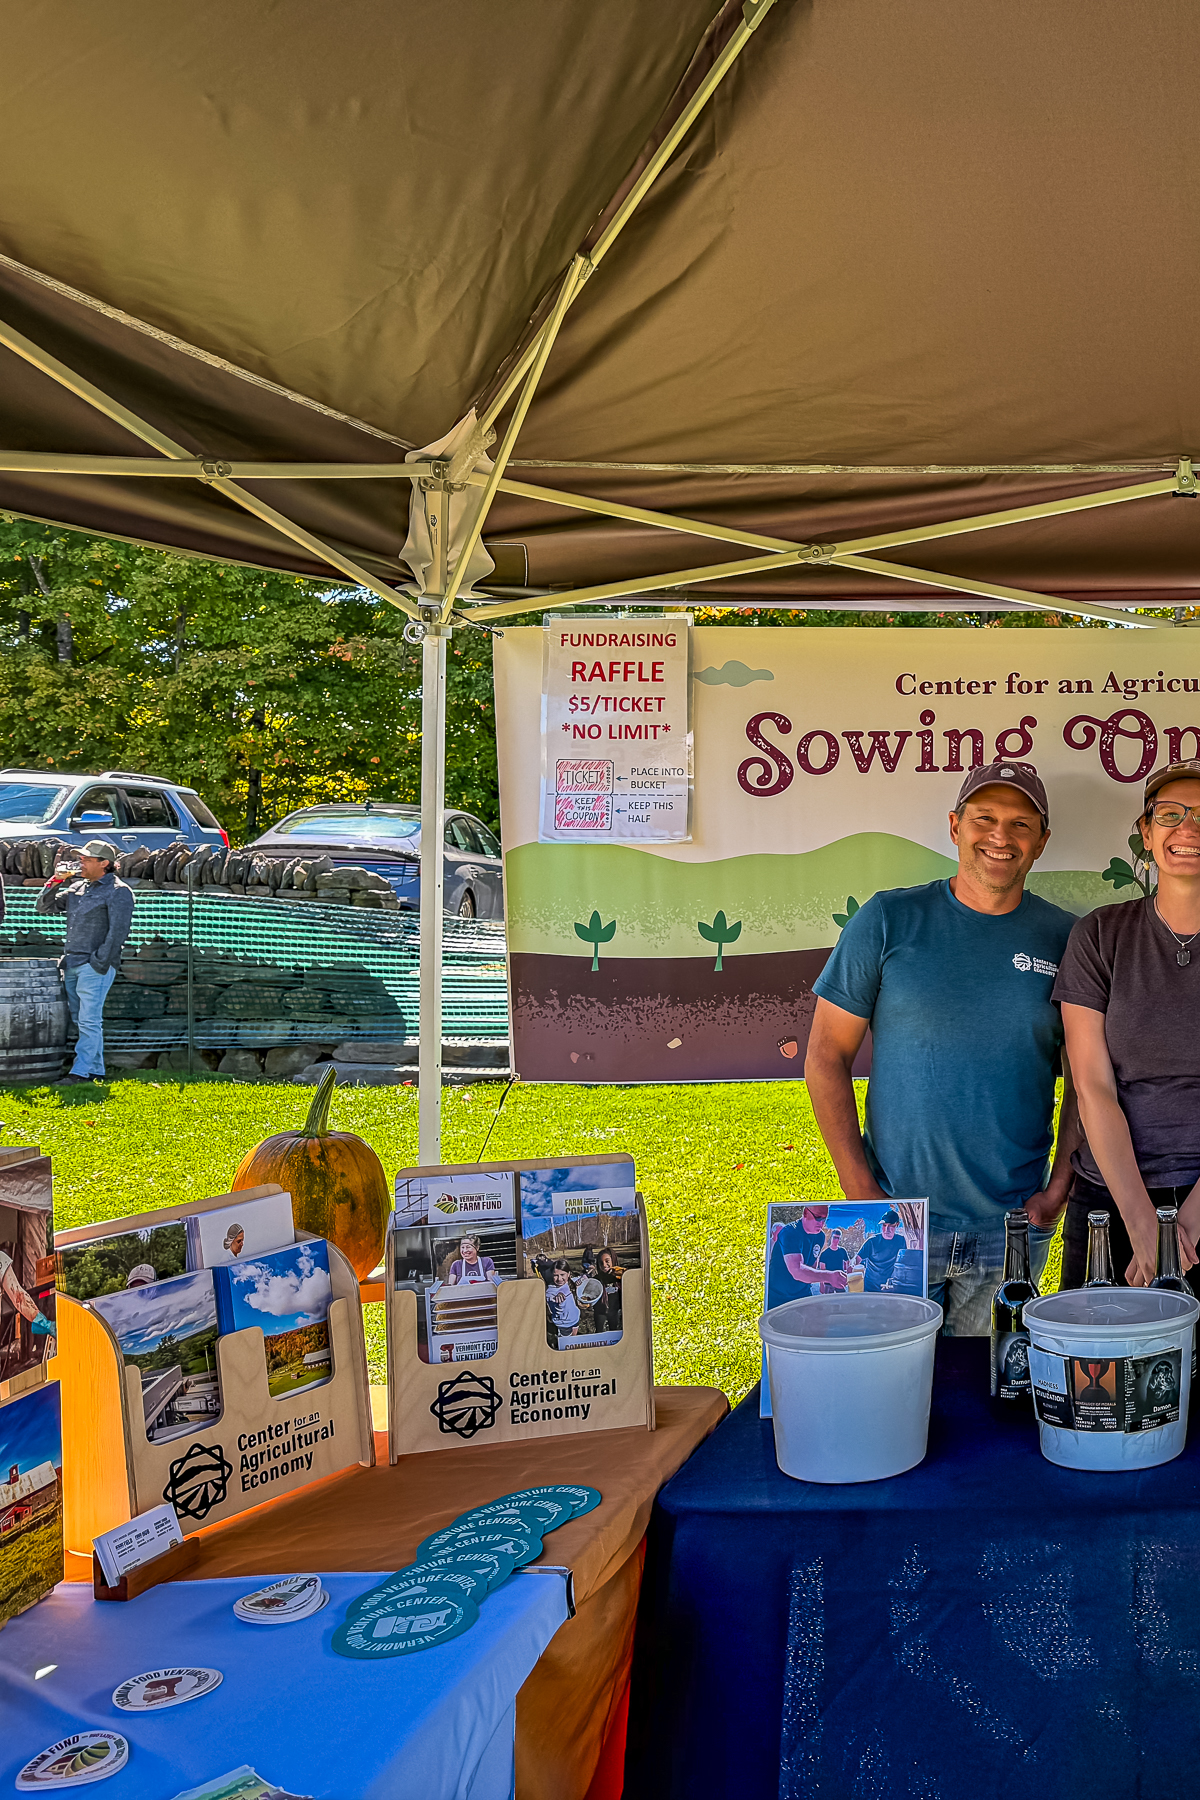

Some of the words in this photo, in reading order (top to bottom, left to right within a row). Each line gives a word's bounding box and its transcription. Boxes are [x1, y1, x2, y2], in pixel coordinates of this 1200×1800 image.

[560, 633, 677, 648] FUNDRAISING
[571, 661, 665, 683] RAFFLE
[895, 673, 997, 696] Center
[1005, 672, 1050, 695] for
[1058, 678, 1094, 695] an
[568, 695, 666, 714] $5/TICKET
[737, 708, 1039, 798] Sowing
[564, 770, 601, 785] TICKET
[630, 768, 659, 776] PLACE
[661, 768, 684, 776] INTO
[630, 781, 666, 789] BUCKET
[575, 797, 596, 805] KEEP
[628, 802, 651, 810] KEEP
[653, 802, 674, 810] THIS
[565, 811, 600, 821] COUPON
[628, 815, 651, 823] HALF
[459, 1194, 485, 1203] VERMONT
[565, 1198, 583, 1207] FARM
[459, 1202, 481, 1212] FARM
[482, 1201, 502, 1211] FUND
[455, 1343, 481, 1352] VERMONT
[482, 1341, 498, 1351] FOO
[509, 1369, 567, 1388] Center
[571, 1369, 585, 1378] for
[588, 1368, 601, 1376] an
[1037, 1378, 1059, 1390] MADNESS
[509, 1378, 616, 1409] Agricultural
[510, 1403, 590, 1425] Economy
[1153, 1403, 1172, 1413] Damon
[237, 1420, 290, 1452] Center
[293, 1416, 306, 1427] for
[308, 1411, 320, 1421] an
[240, 1419, 335, 1473] Agricultural
[241, 1451, 313, 1493] Economy
[484, 1500, 534, 1514] VENTURE
[478, 1517, 521, 1526] CENTER
[454, 1534, 502, 1547] CENTER
[402, 1556, 453, 1577] ENTURE
[456, 1553, 498, 1563] CENTER
[261, 1575, 301, 1594] CONNEX
[381, 1573, 444, 1594] VENTURE
[443, 1573, 477, 1590] CENTER
[396, 1596, 448, 1609] CENTER
[346, 1605, 395, 1635] VENTURE
[363, 1635, 435, 1652] VERMONT
[132, 1671, 161, 1685] FOOD
[47, 1734, 80, 1755] FUND
